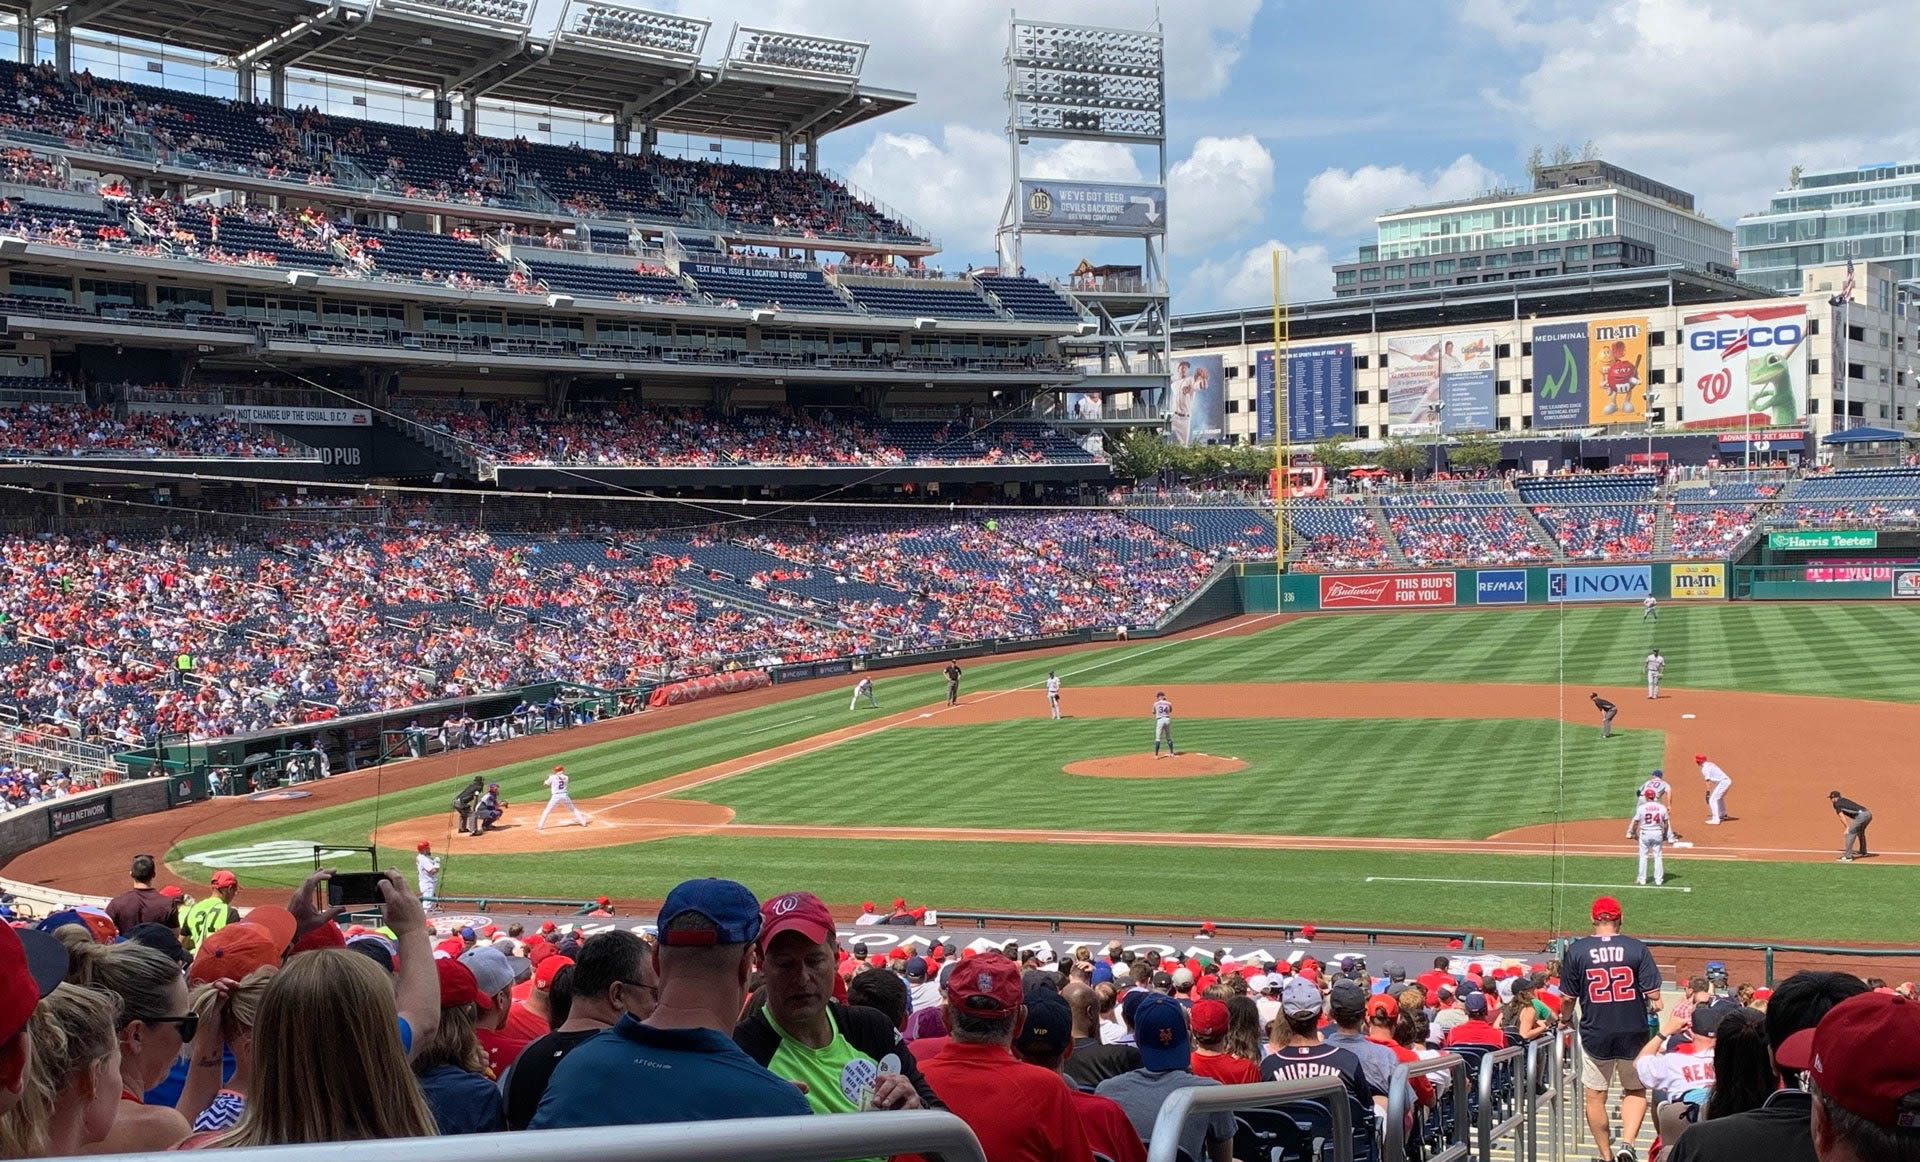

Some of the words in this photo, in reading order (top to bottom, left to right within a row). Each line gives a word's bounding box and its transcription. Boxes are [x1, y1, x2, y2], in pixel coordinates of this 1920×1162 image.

[1059, 190, 1084, 201] WE'VE
[1086, 192, 1102, 202] GOT
[1034, 195, 1048, 210] DB
[1061, 202, 1086, 213] DEVILS
[1087, 203, 1125, 214] BACKBONE
[696, 265, 710, 273] TEXT
[711, 266, 728, 275] NATS,
[729, 267, 745, 276] ISSUE
[745, 269, 751, 277] &
[752, 269, 779, 278] LOCATION
[780, 271, 788, 279] TO
[1535, 331, 1586, 342] MEDLIMINAL
[238, 409, 251, 420] NOT
[253, 409, 281, 421] CHANGE
[281, 410, 291, 421] UP
[292, 410, 305, 421] THE
[1778, 432, 1800, 440] SALES
[334, 447, 361, 466] PUB
[1788, 536, 1829, 547] Harris
[1832, 535, 1873, 546] Teeter
[1395, 578, 1419, 588] THIS
[1421, 577, 1453, 588] BUD'S
[1479, 581, 1524, 592] RE/MAX
[1574, 574, 1649, 593] INOVA
[1331, 584, 1384, 597] Budweiser
[1395, 591, 1416, 602] FOR
[1418, 590, 1442, 601] YOU.
[1283, 592, 1295, 602] 336
[1158, 706, 1169, 715] 34
[558, 780, 565, 790] 2
[62, 811, 76, 824] MLB
[75, 804, 106, 820] NETWORK
[1645, 813, 1661, 824] 24
[194, 907, 223, 936] 27
[1589, 946, 1625, 964] SOTO
[1586, 966, 1636, 1004] 22
[1033, 1027, 1048, 1036] VIP
